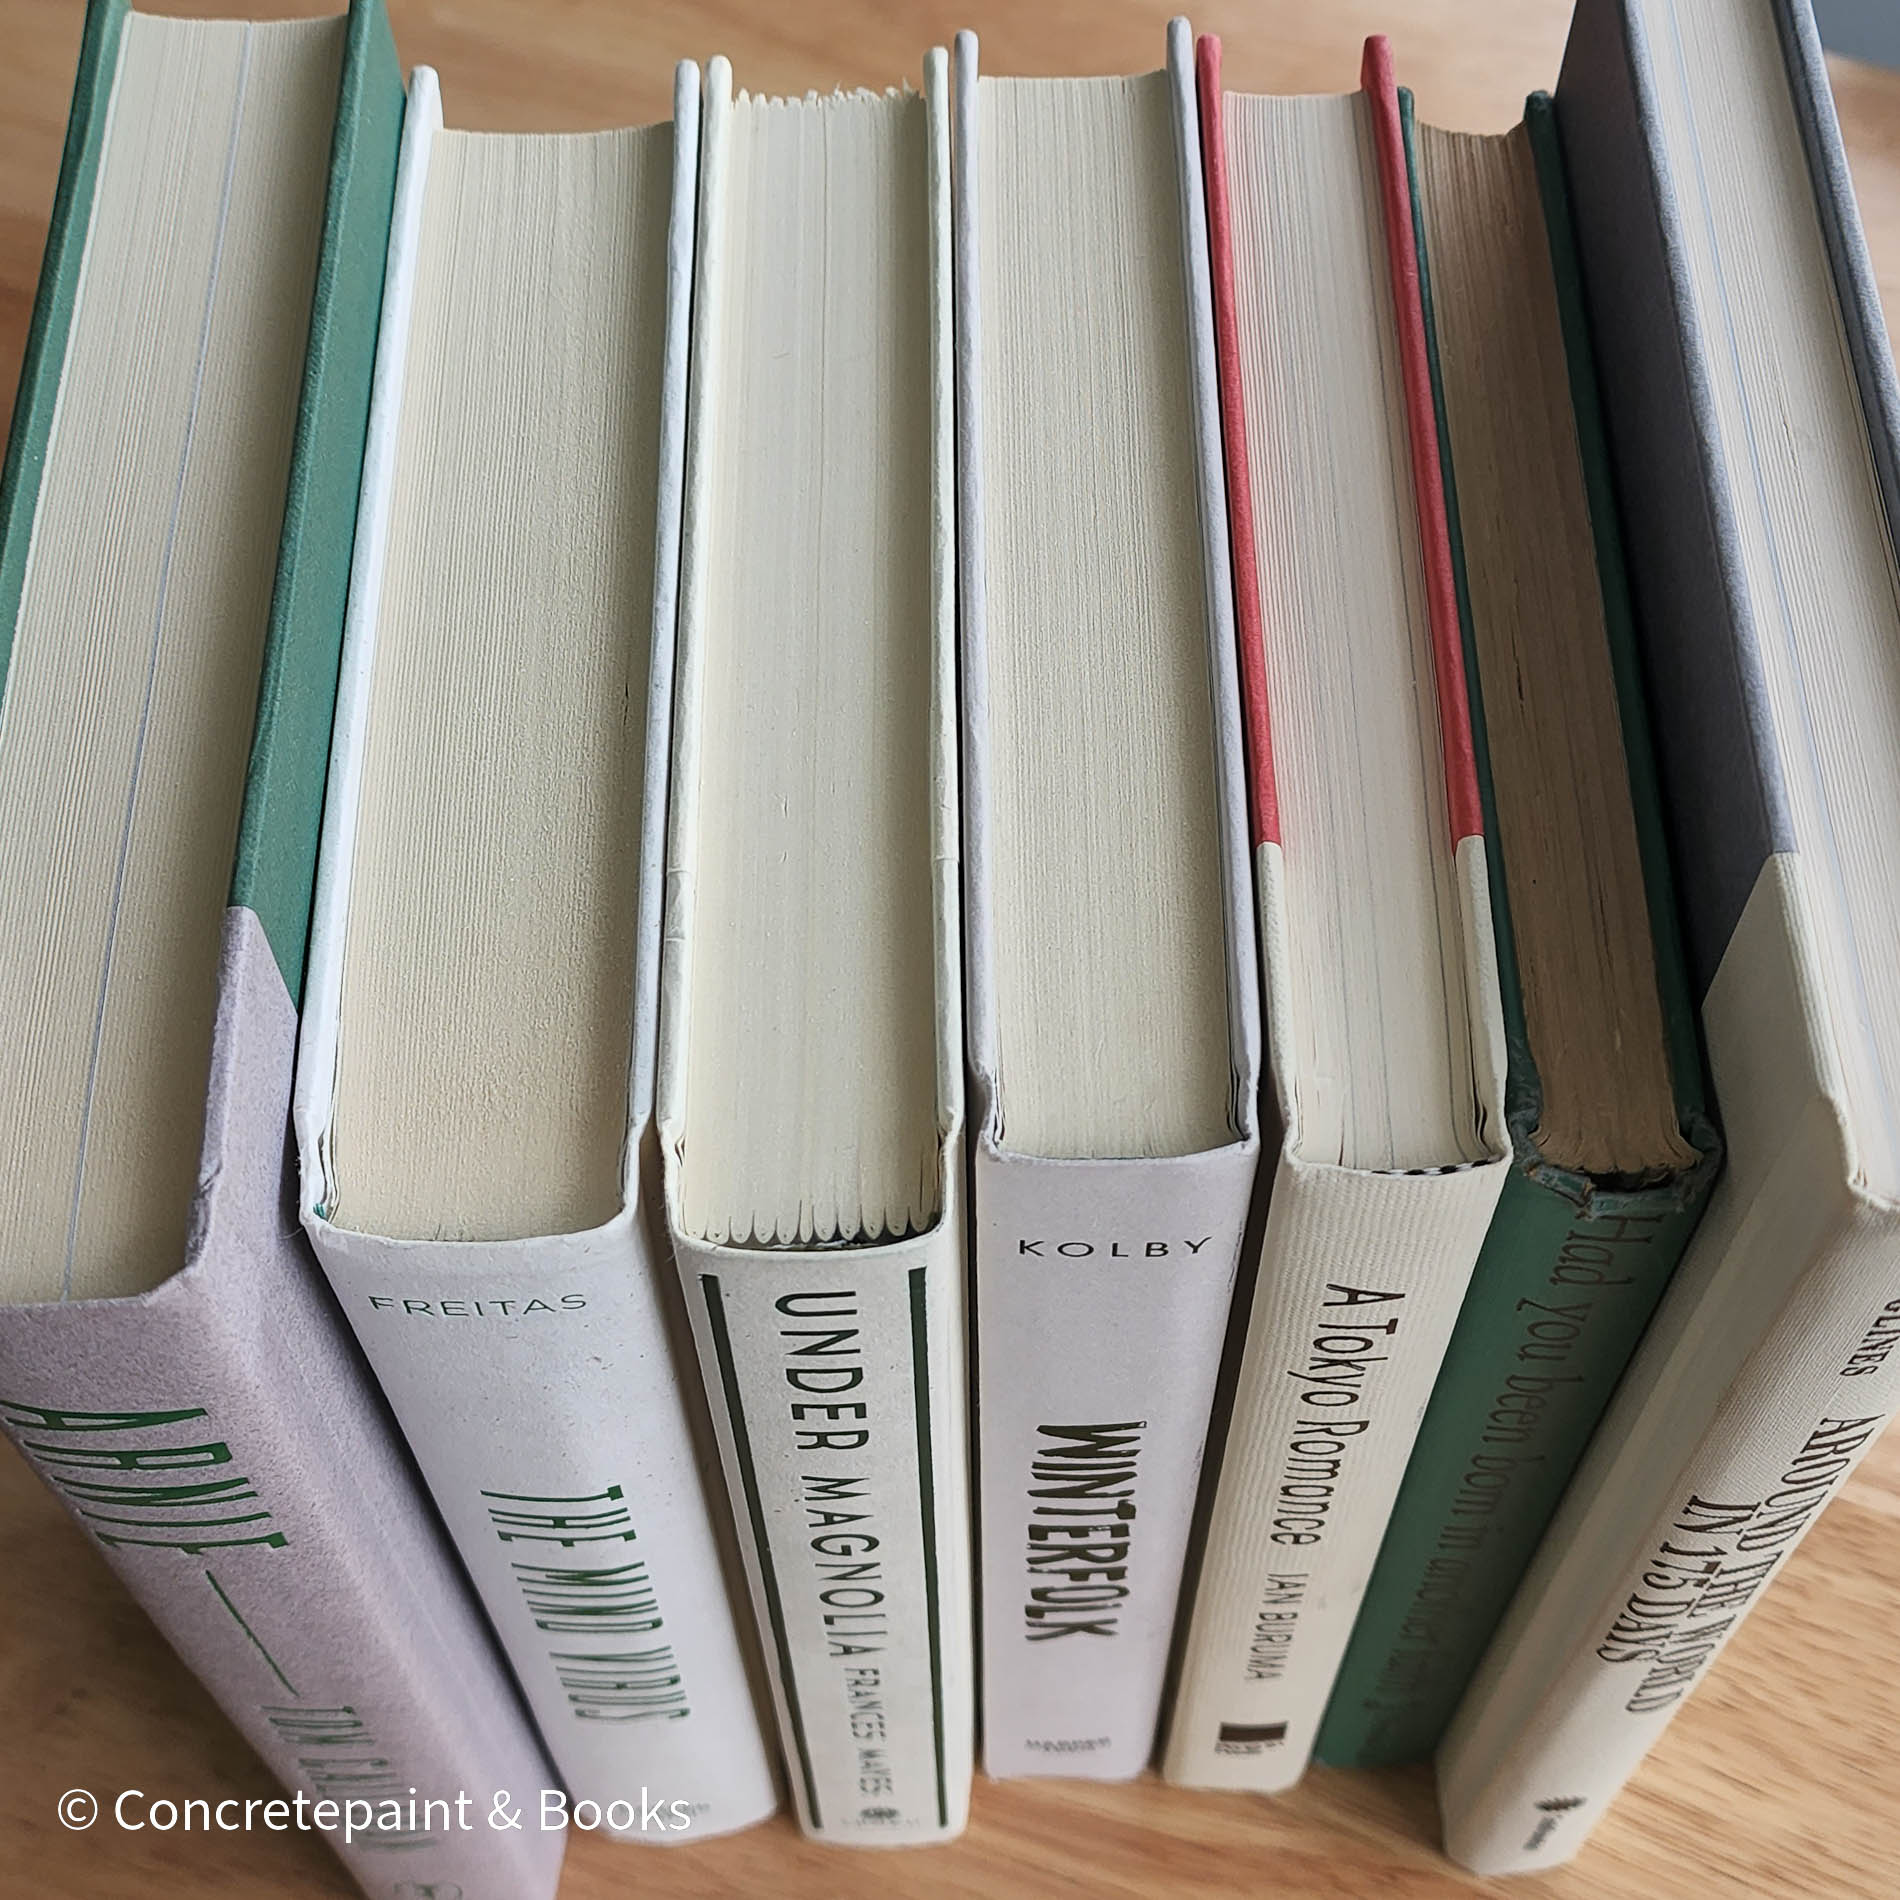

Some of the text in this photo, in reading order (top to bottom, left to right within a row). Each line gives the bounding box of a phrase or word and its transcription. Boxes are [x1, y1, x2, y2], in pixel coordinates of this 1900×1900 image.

[1019, 1236, 1212, 1258] KOLBY
[1550, 1212, 1667, 1287] Had
[368, 1294, 586, 1317] FREITAS
[1516, 1295, 1594, 1362] you
[775, 1290, 869, 1450] UNDER
[1270, 1283, 1406, 1545] A Tokyo Romance
[1481, 1373, 1586, 1444] been
[0, 1401, 290, 1555] ARNIE
[480, 1484, 636, 1547] THE
[1025, 1421, 1147, 1641] WINTERFOLK
[511, 1561, 664, 1633] MIND
[801, 1475, 889, 1656] MAGNOLIA
[1262, 1572, 1309, 1605] IAN
[1597, 1495, 1761, 1662] IN 175 DAYS
[1625, 1413, 1886, 1712] AROUND THE WORLD
[549, 1645, 690, 1720] VIRUS
[1244, 1611, 1299, 1681] BURUMA
[844, 1667, 887, 1740] FRANCES
